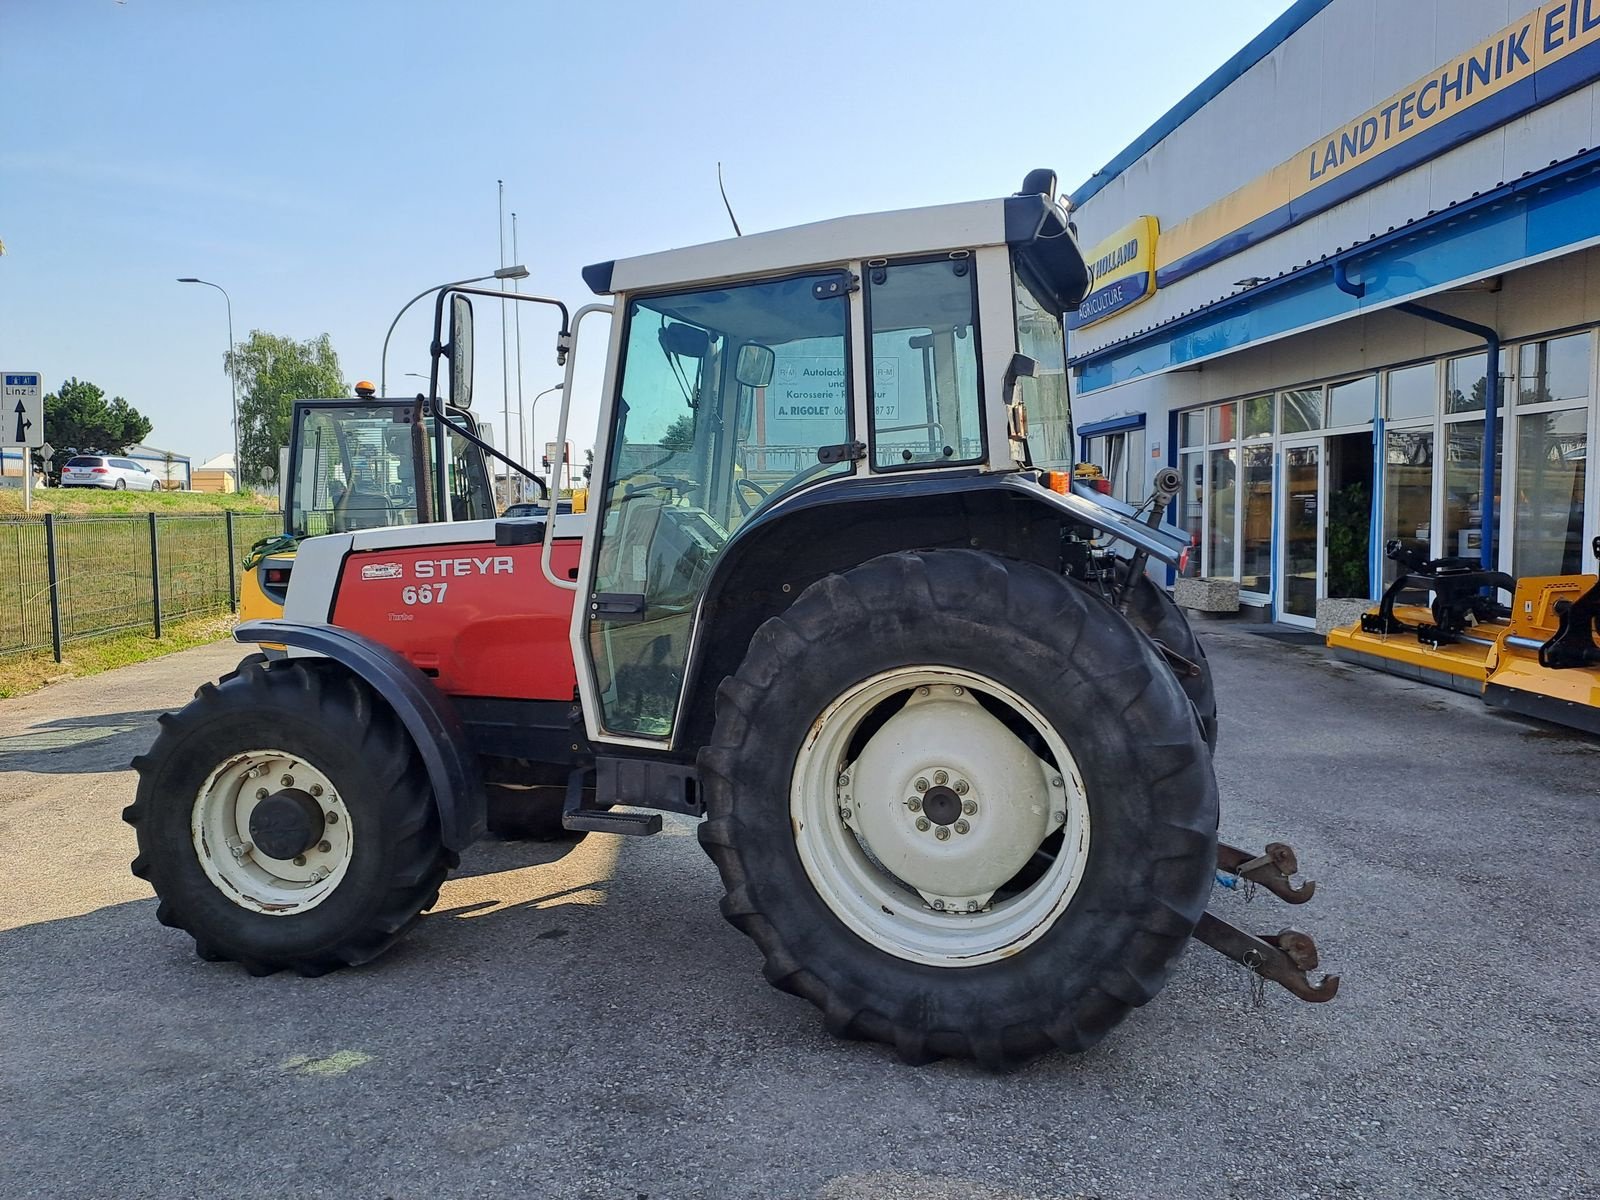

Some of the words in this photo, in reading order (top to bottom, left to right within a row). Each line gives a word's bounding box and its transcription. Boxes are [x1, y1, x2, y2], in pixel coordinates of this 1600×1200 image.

[1309, 23, 1531, 182] LANDTECHNIK
[1095, 239, 1138, 281] HOLLAND
[1079, 285, 1123, 320] AGRICULTURE
[6, 387, 26, 395] Linz
[786, 390, 834, 399] Karosserie
[778, 406, 788, 416] A.
[790, 406, 829, 416] RIGOLET
[885, 406, 895, 416] 37
[414, 556, 514, 579] STEYR
[402, 583, 448, 606] 667
